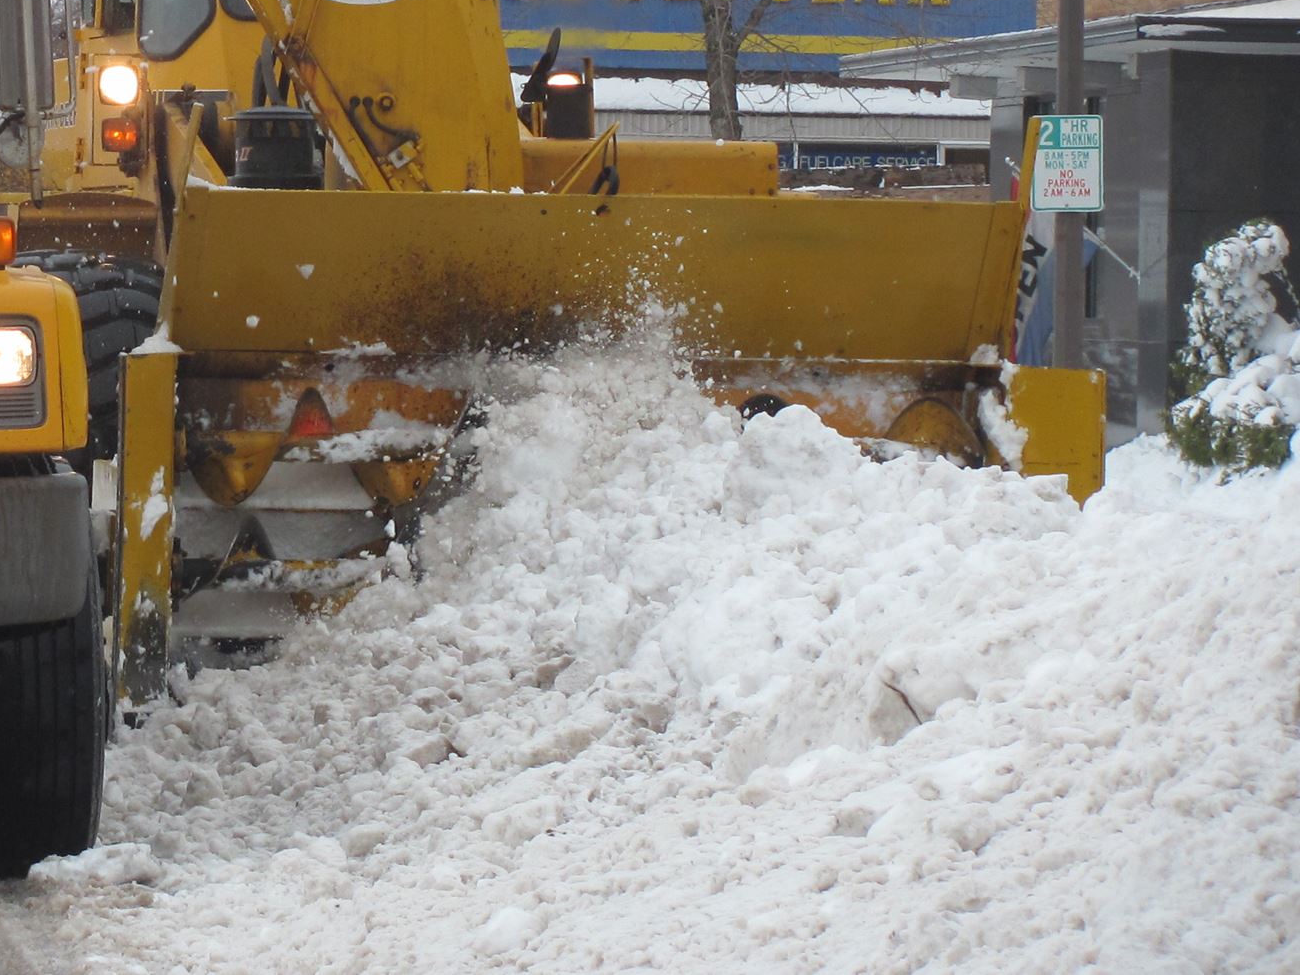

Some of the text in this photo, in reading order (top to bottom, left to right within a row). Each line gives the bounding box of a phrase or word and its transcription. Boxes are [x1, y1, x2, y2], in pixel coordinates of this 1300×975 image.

[1039, 119, 1088, 146] 2 HR
[1061, 133, 1098, 146] PARKING
[1060, 170, 1073, 178] NO
[1048, 179, 1085, 187] PARKING
